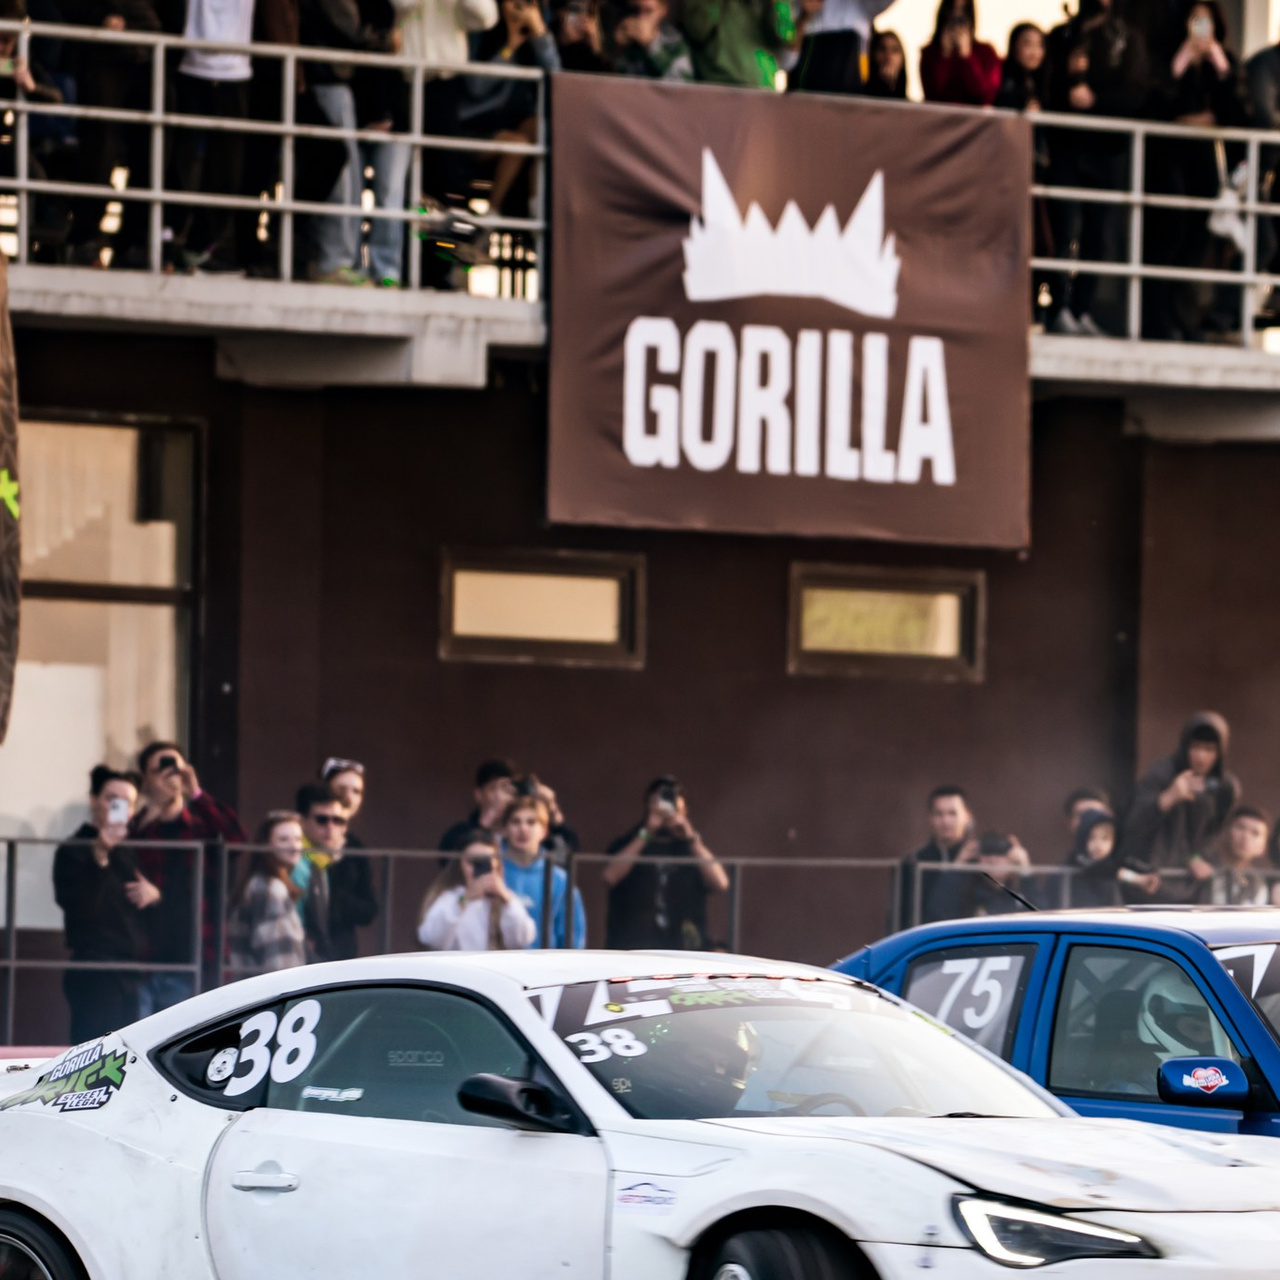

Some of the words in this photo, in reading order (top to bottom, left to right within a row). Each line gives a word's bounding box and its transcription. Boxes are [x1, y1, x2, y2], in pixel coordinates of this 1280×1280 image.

[623, 316, 956, 486] GORILLA
[936, 956, 1011, 1029] 75
[49, 1045, 103, 1081] GORILLA
[223, 999, 322, 1097] 38
[388, 1050, 444, 1066] sparco
[564, 1028, 648, 1064] 38
[60, 1088, 103, 1102] STREET
[68, 1098, 101, 1108] LEGAL
